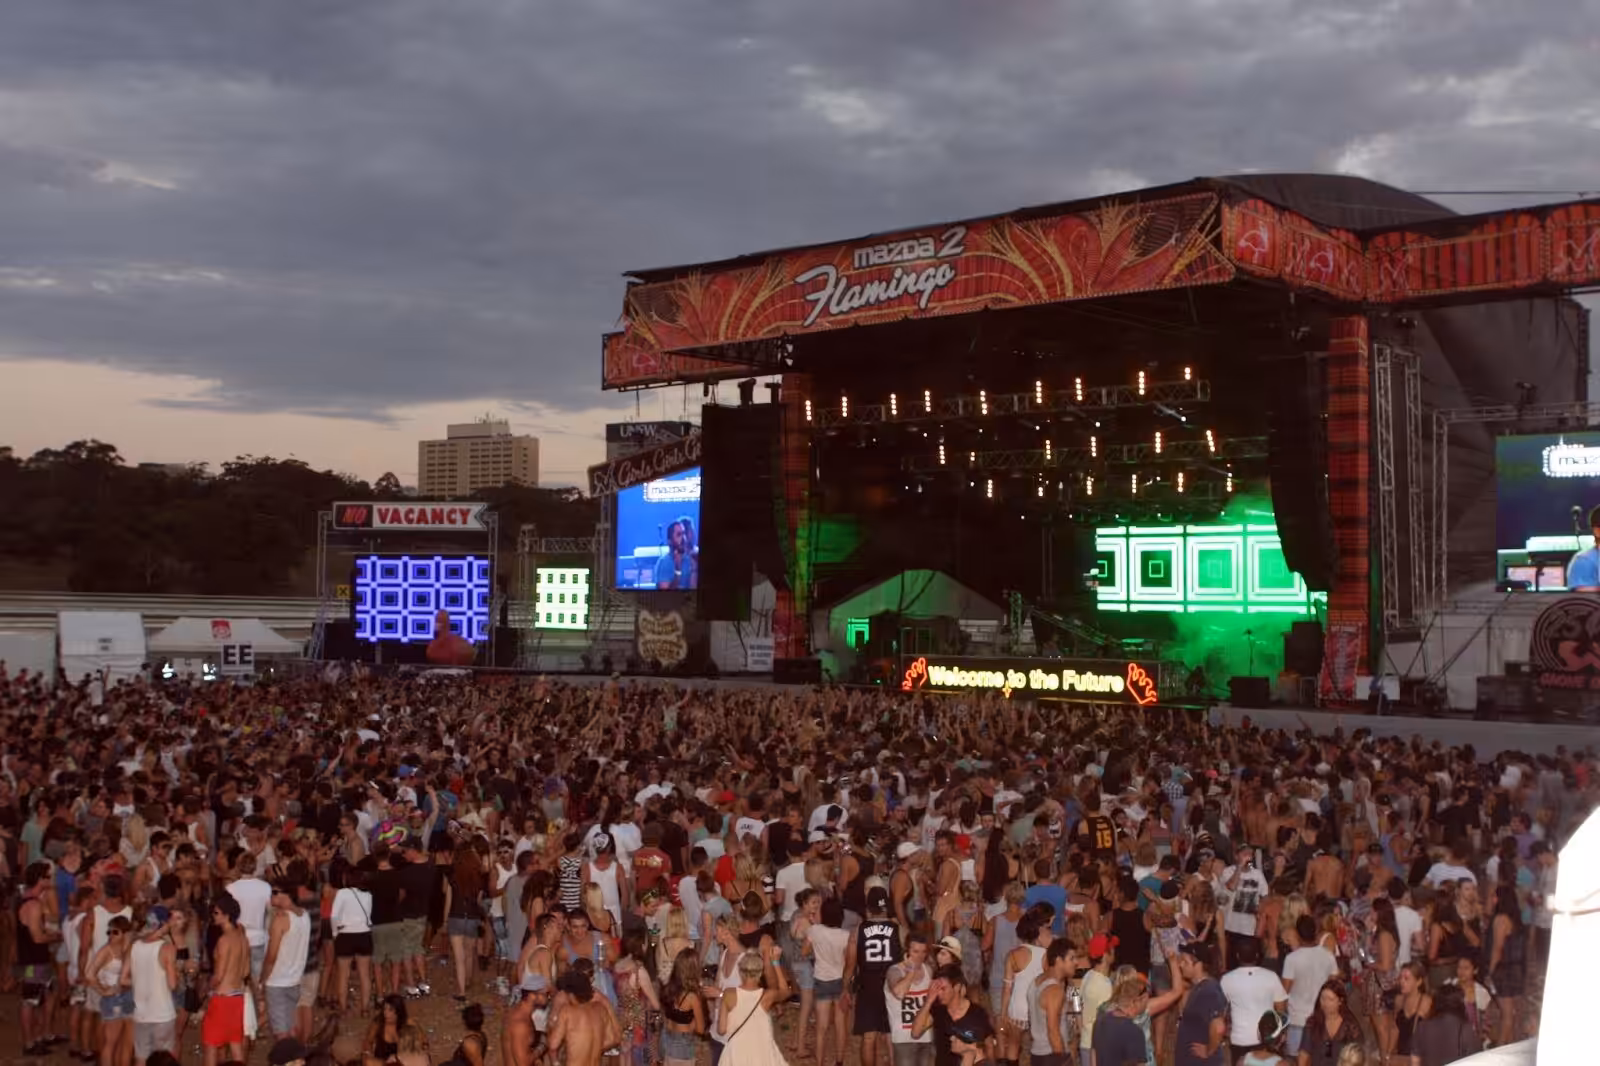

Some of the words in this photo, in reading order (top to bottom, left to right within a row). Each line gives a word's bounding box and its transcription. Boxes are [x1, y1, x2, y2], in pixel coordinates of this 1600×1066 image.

[853, 236, 935, 268] mazda
[937, 225, 967, 257] 2
[795, 264, 955, 327] Flamingo
[342, 506, 369, 524] NO
[377, 507, 472, 524] VACANCY
[223, 645, 253, 665] EE
[927, 665, 1004, 688] Welcome
[1006, 668, 1026, 689] to
[1029, 669, 1060, 690] the
[1062, 669, 1125, 693] Future
[863, 925, 893, 938] DUNCAN
[865, 939, 893, 963] 21
[902, 996, 928, 1011] RU
